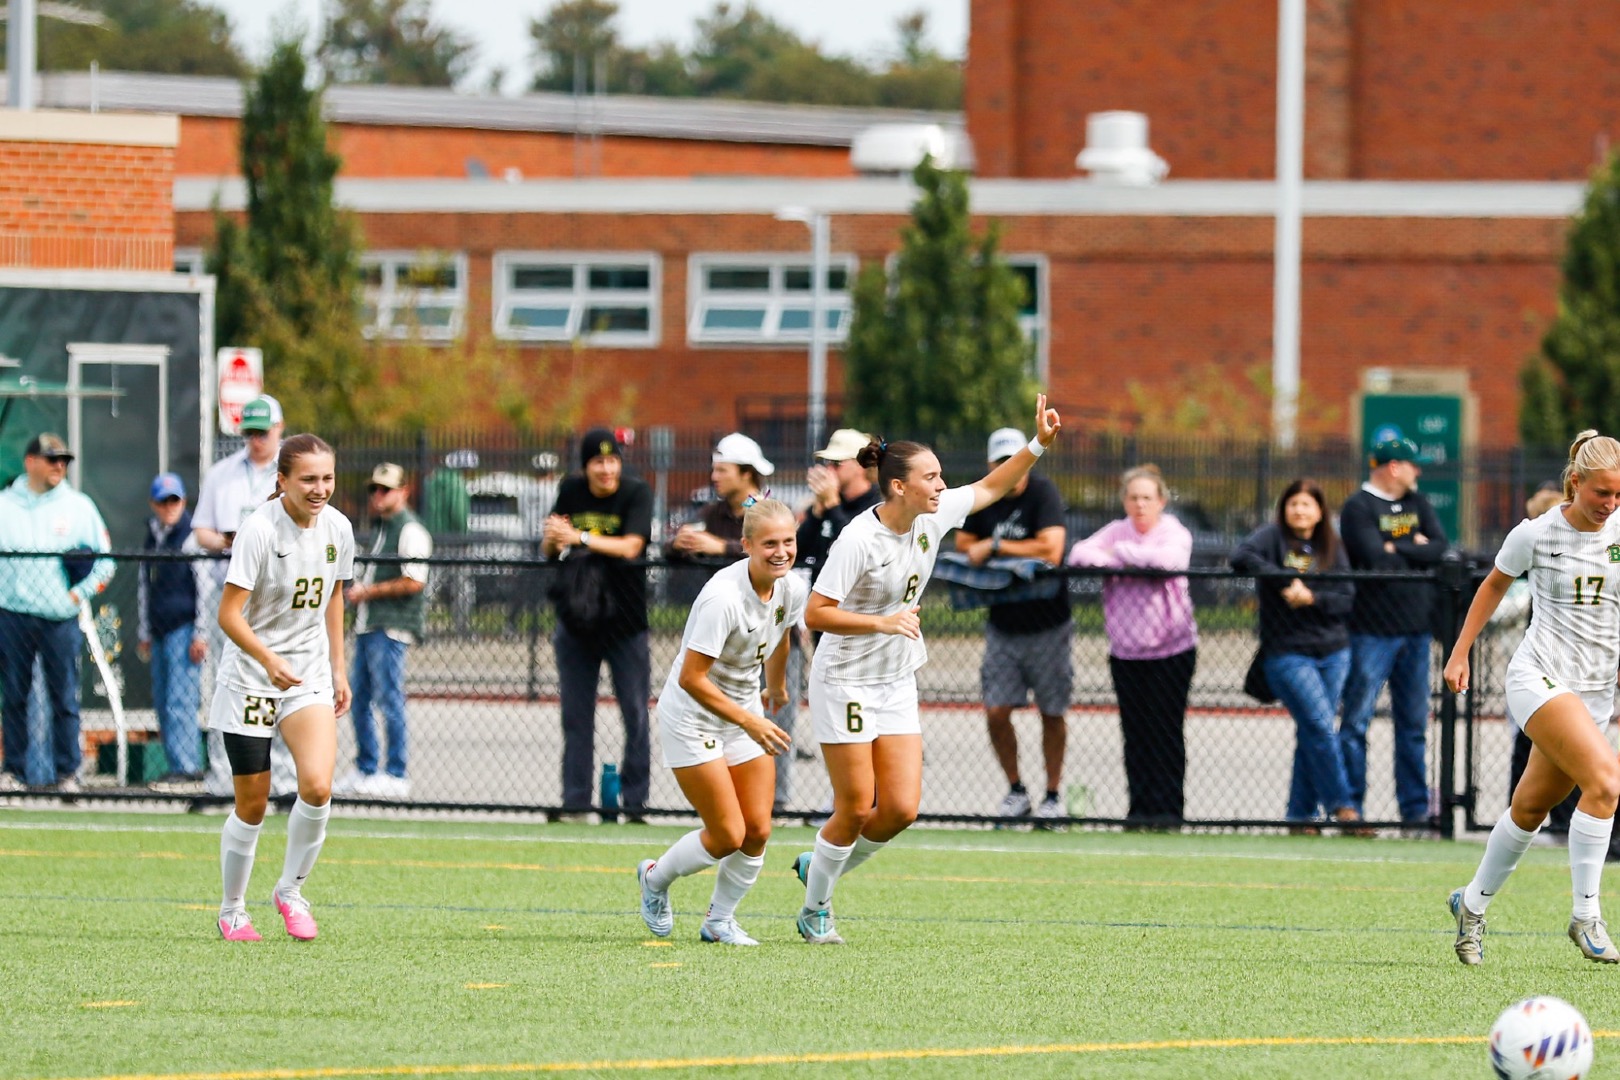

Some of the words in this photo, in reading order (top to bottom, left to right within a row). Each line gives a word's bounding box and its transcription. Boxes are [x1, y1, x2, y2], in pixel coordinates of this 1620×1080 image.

[326, 544, 337, 563] B
[291, 576, 324, 609] 23
[903, 573, 920, 604] 6
[1574, 575, 1605, 606] 17
[244, 695, 277, 727] 23
[846, 701, 863, 733] 6
